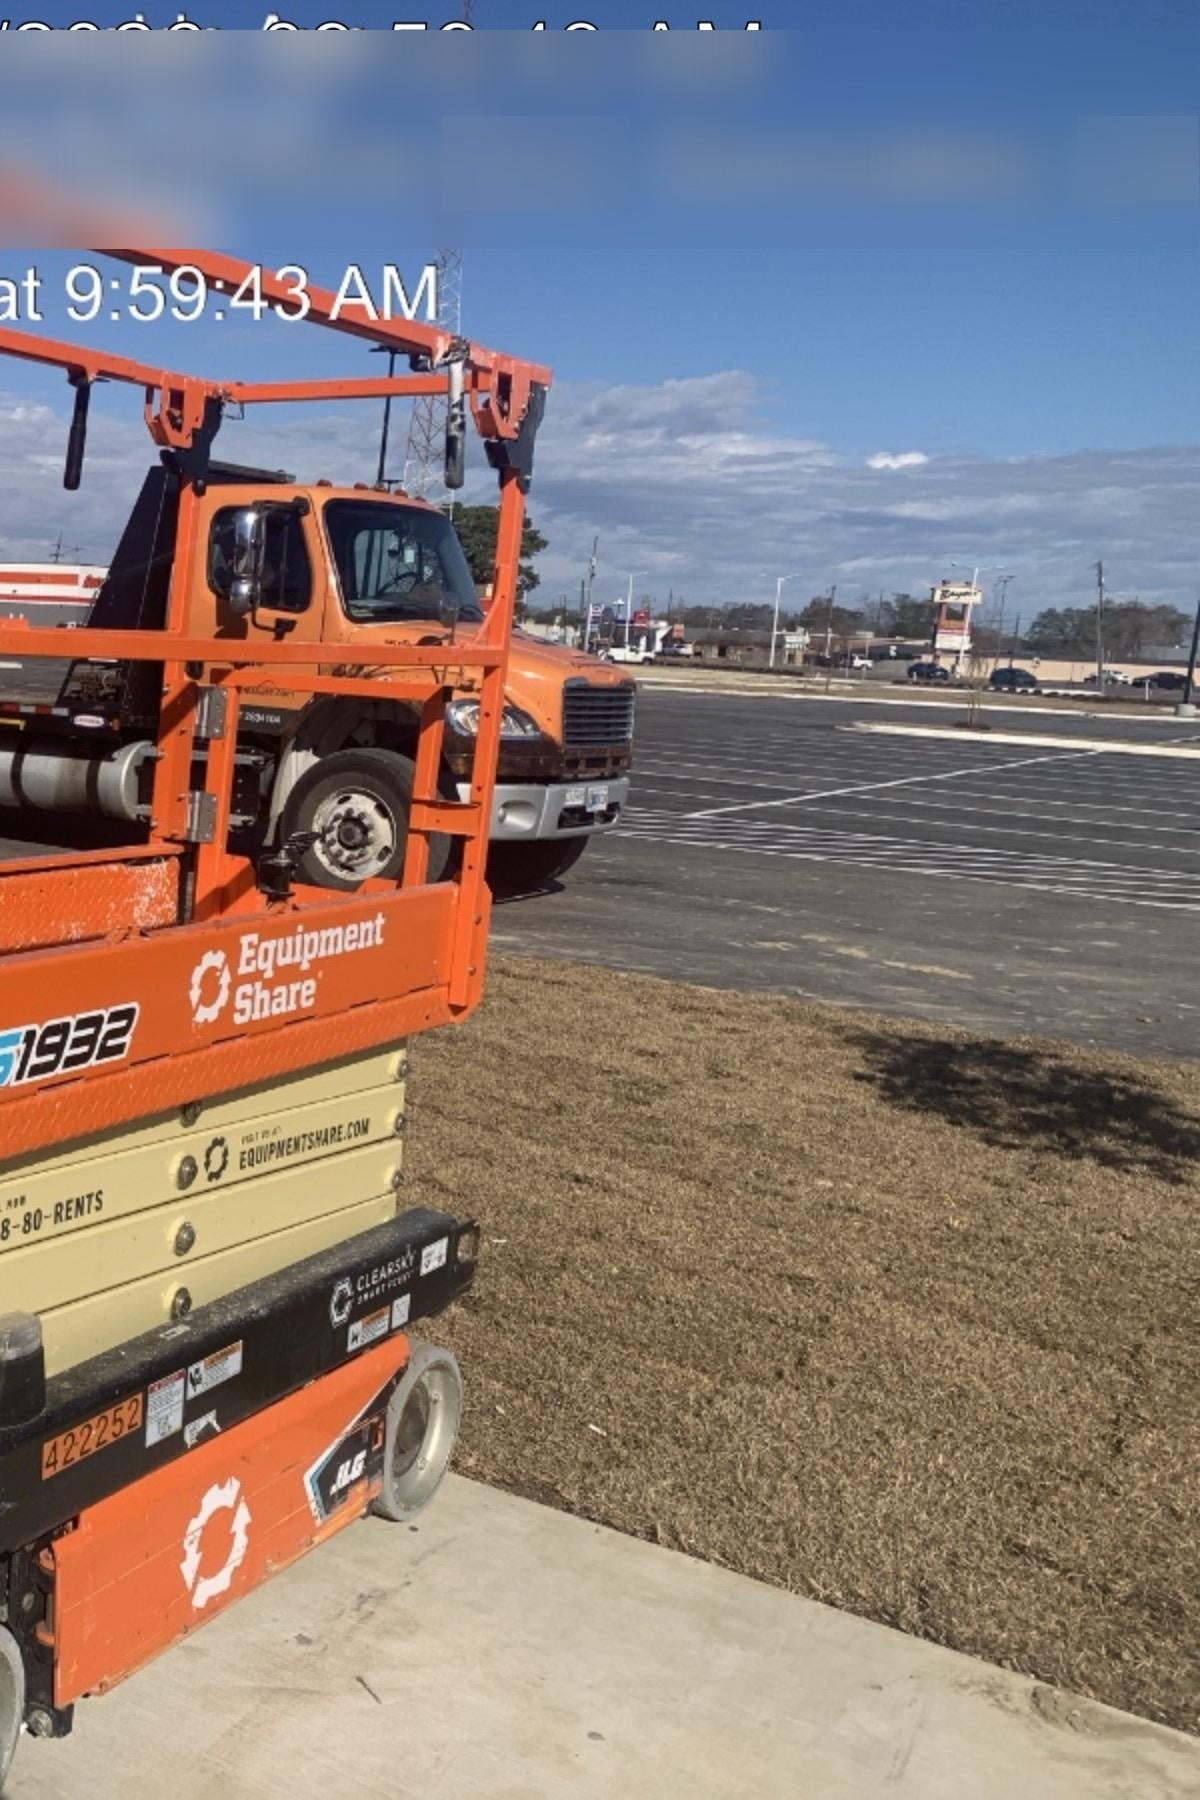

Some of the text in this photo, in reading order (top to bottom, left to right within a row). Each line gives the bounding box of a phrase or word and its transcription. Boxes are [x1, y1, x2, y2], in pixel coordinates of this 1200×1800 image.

[237, 912, 386, 978] Equipment
[233, 977, 317, 1025] Share
[239, 1118, 370, 1170] EQUIPMENTSHARE.COM
[357, 1244, 416, 1291] CLEARSKY
[45, 1398, 139, 1471] 422252
[330, 1449, 367, 1496] JLG
